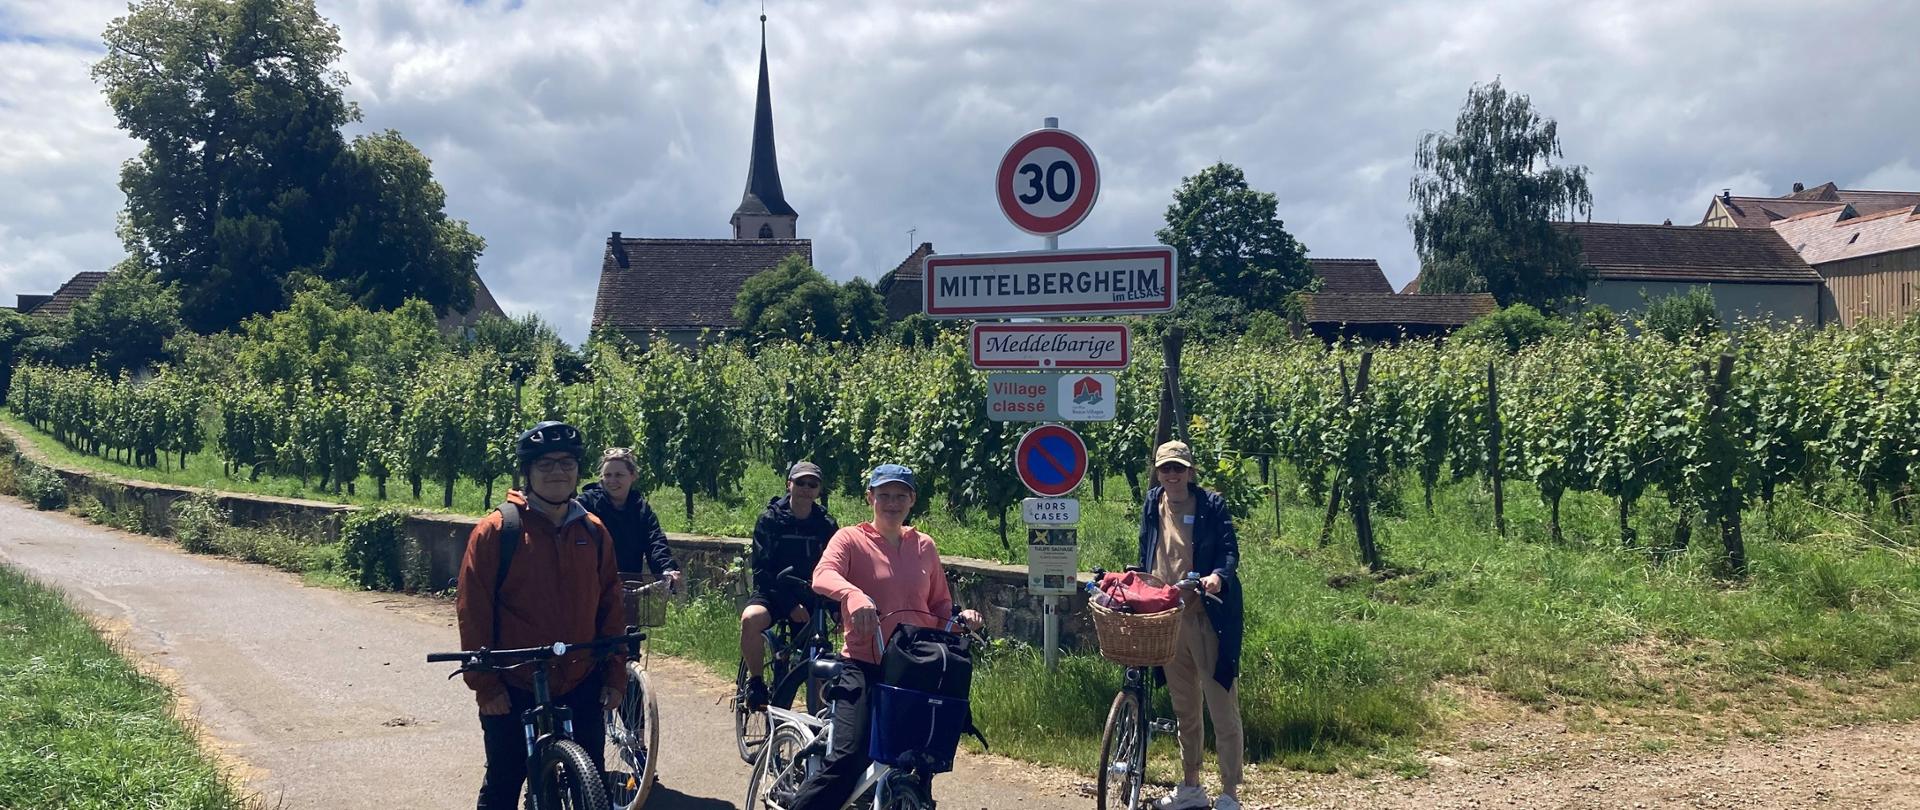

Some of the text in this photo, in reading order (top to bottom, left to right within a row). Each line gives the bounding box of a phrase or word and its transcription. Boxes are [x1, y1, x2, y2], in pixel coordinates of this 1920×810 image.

[1019, 160, 1076, 205] 30
[940, 269, 1159, 298] MITTELBERGHEIM
[985, 333, 1115, 359] Meddelbarige
[993, 382, 1047, 397] Village
[993, 399, 1046, 413] classé
[1037, 502, 1066, 511] HORS
[1034, 512, 1069, 521] CASES
